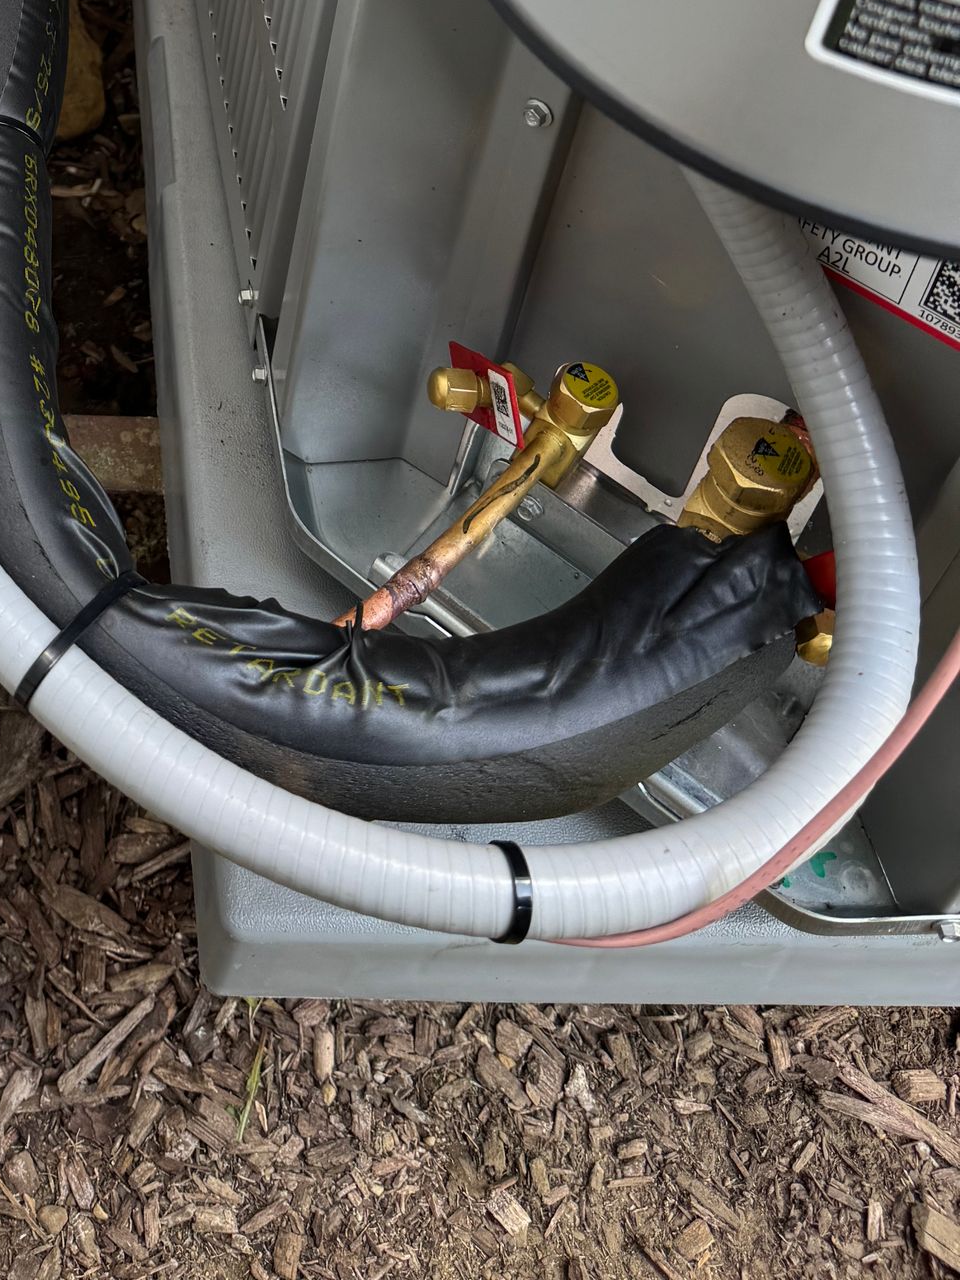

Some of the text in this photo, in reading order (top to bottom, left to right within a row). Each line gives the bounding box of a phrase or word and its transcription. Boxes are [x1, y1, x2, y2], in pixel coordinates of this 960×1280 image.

[798, 217, 842, 246] FETY
[817, 245, 850, 274] A2L
[164, 606, 410, 710] RETARDANT
